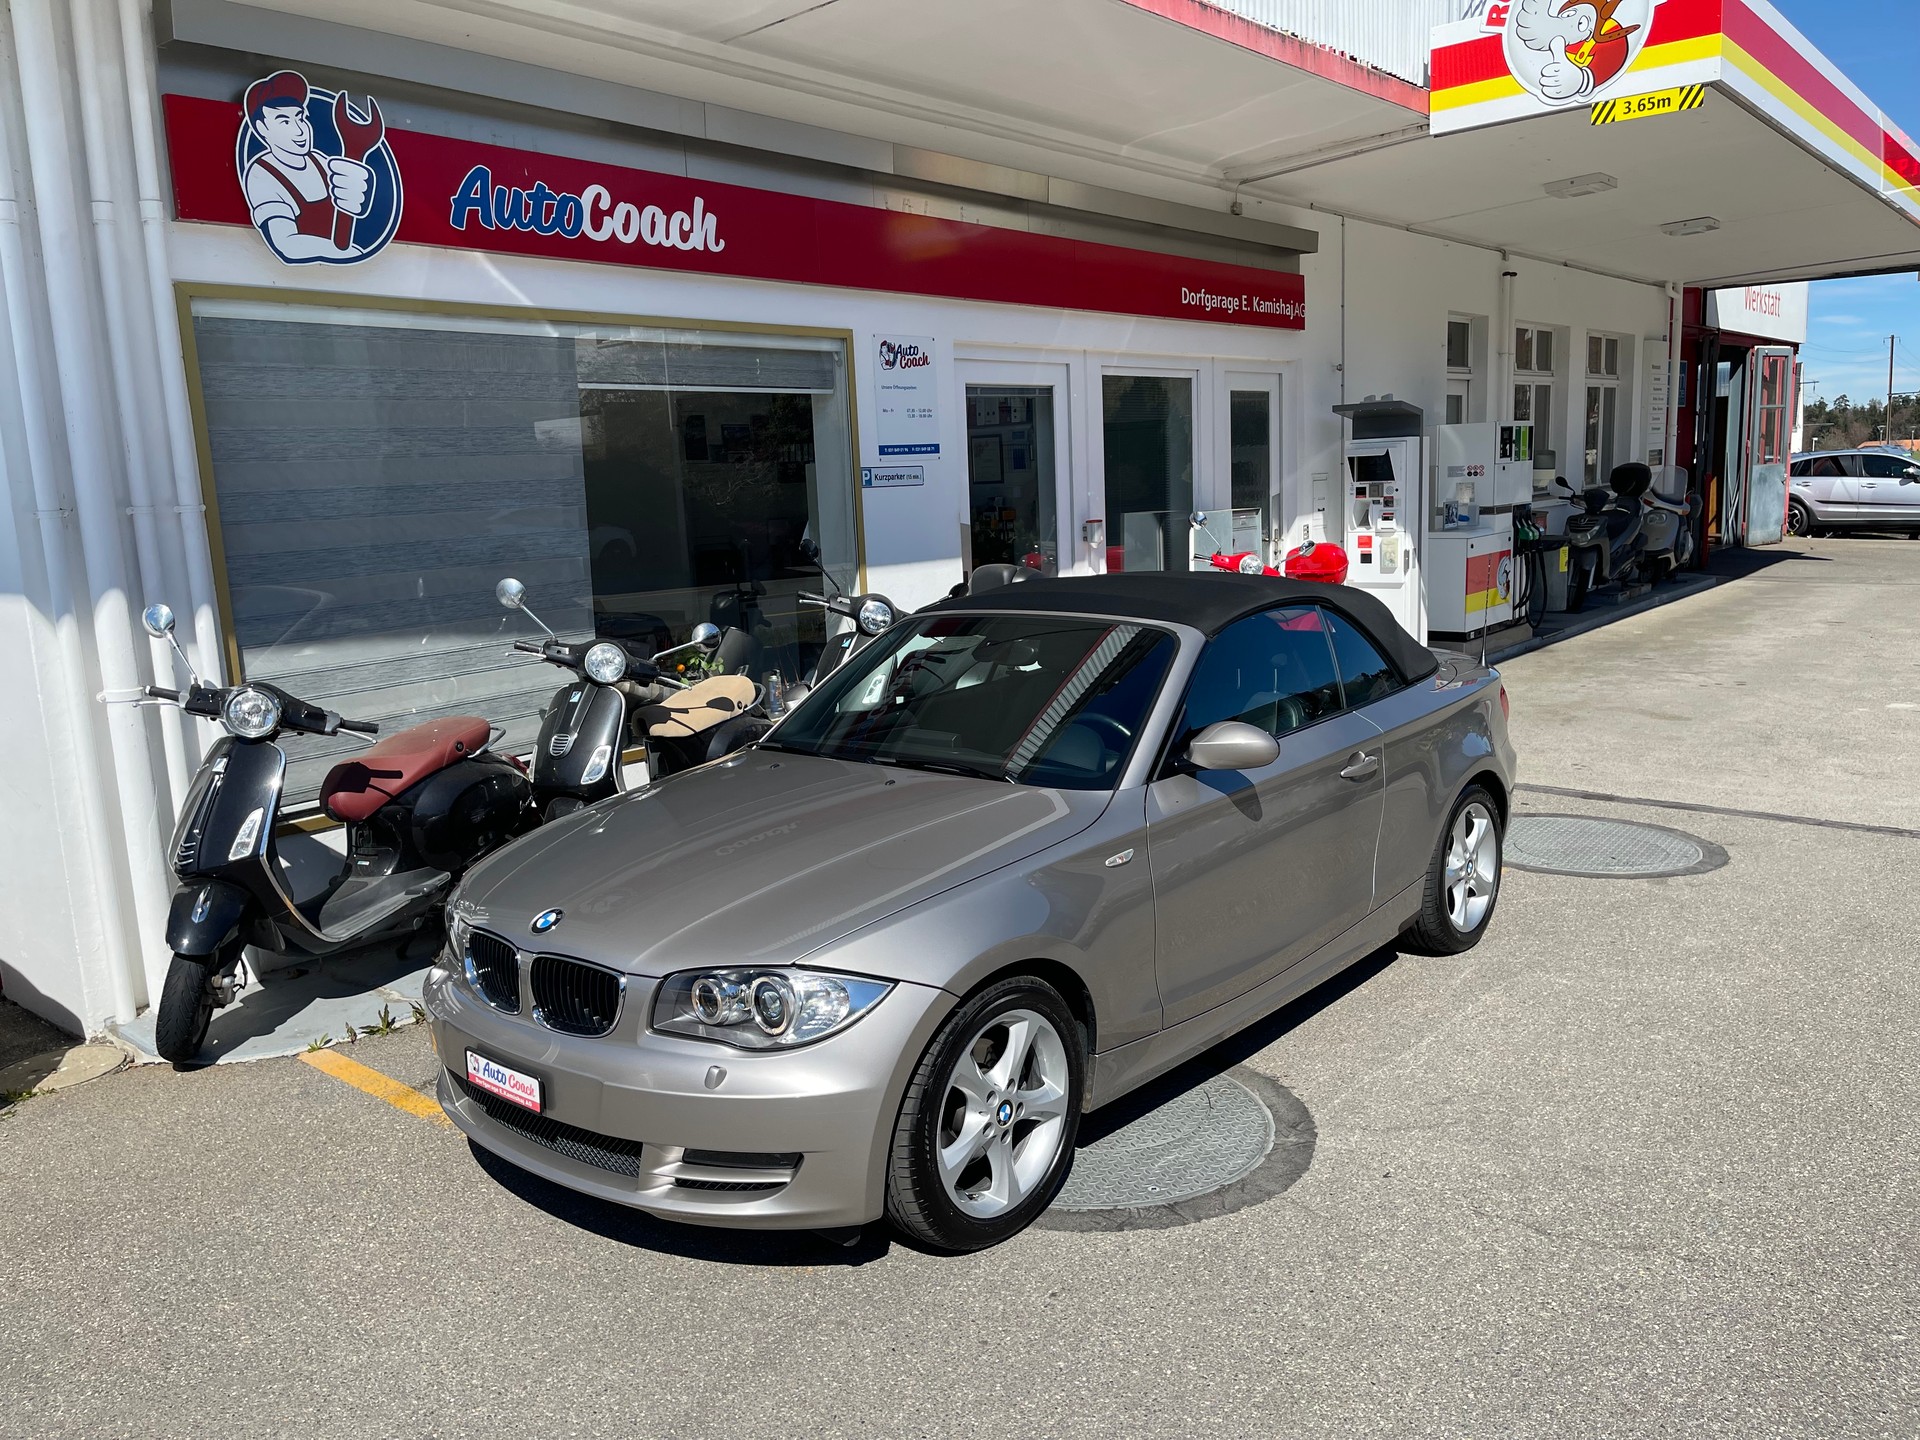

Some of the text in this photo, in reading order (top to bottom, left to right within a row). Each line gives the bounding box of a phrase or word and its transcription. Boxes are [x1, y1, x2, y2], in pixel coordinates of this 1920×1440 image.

[1486, 0, 1511, 27] R
[1623, 96, 1671, 115] 3.65m
[450, 164, 725, 253] AutoCoach
[1181, 287, 1239, 313] Dorfgarage
[1241, 295, 1250, 311] E.
[1744, 285, 1781, 317] Werkstatt
[896, 344, 919, 359] Auto
[899, 352, 930, 370] Coach
[862, 471, 870, 485] P
[874, 473, 905, 482] Kurzparker
[483, 1061, 535, 1096] Auto Coach
